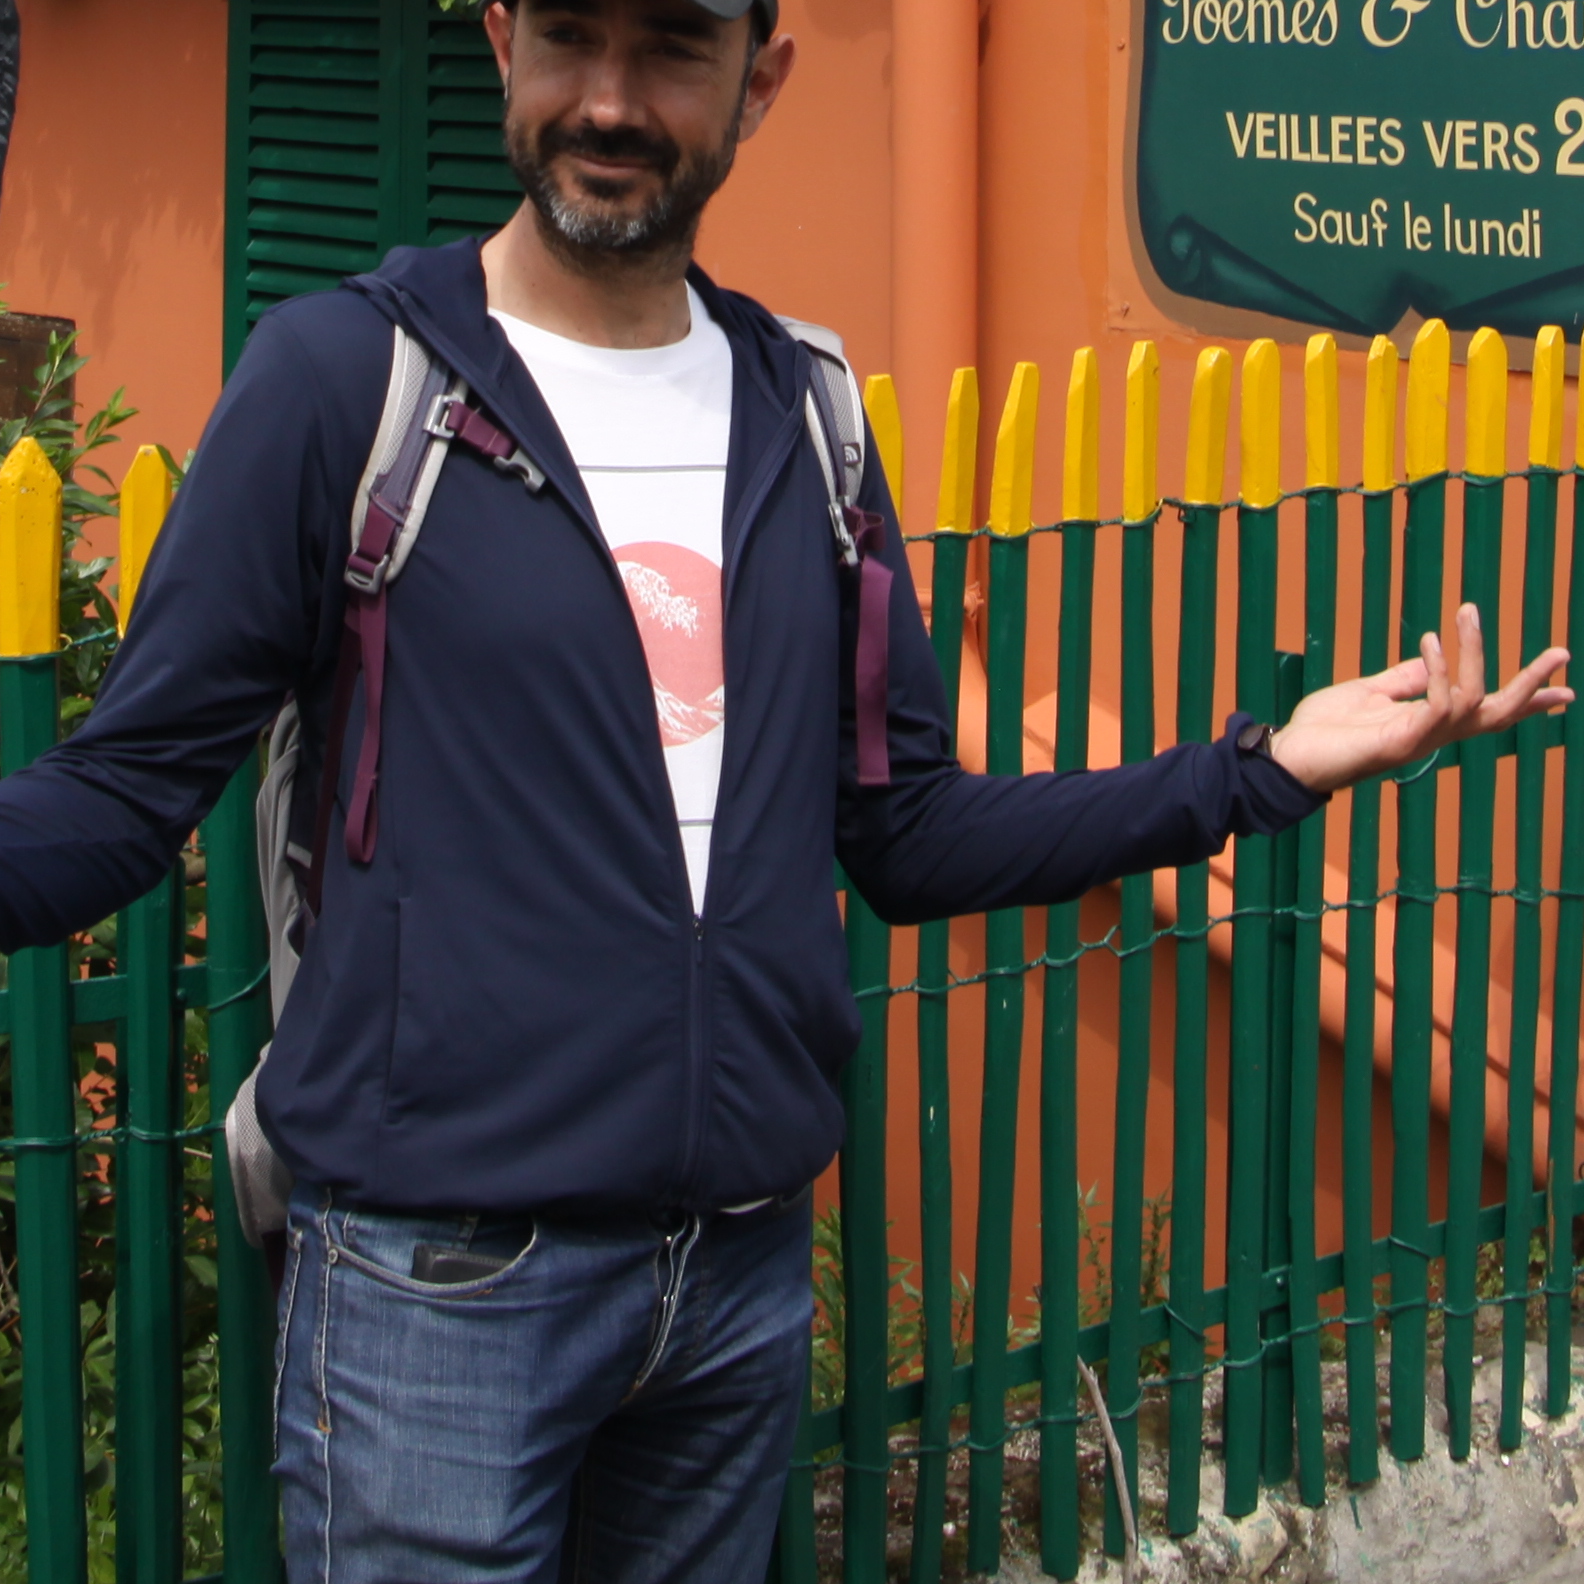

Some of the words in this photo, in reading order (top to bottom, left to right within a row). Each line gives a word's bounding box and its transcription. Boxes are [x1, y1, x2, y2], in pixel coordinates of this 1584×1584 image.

[1225, 111, 1405, 167] VEILLEES
[1422, 120, 1541, 175] VERS
[1293, 192, 1388, 249] Sauf
[1403, 201, 1433, 253] le
[1443, 203, 1543, 260] lundi
